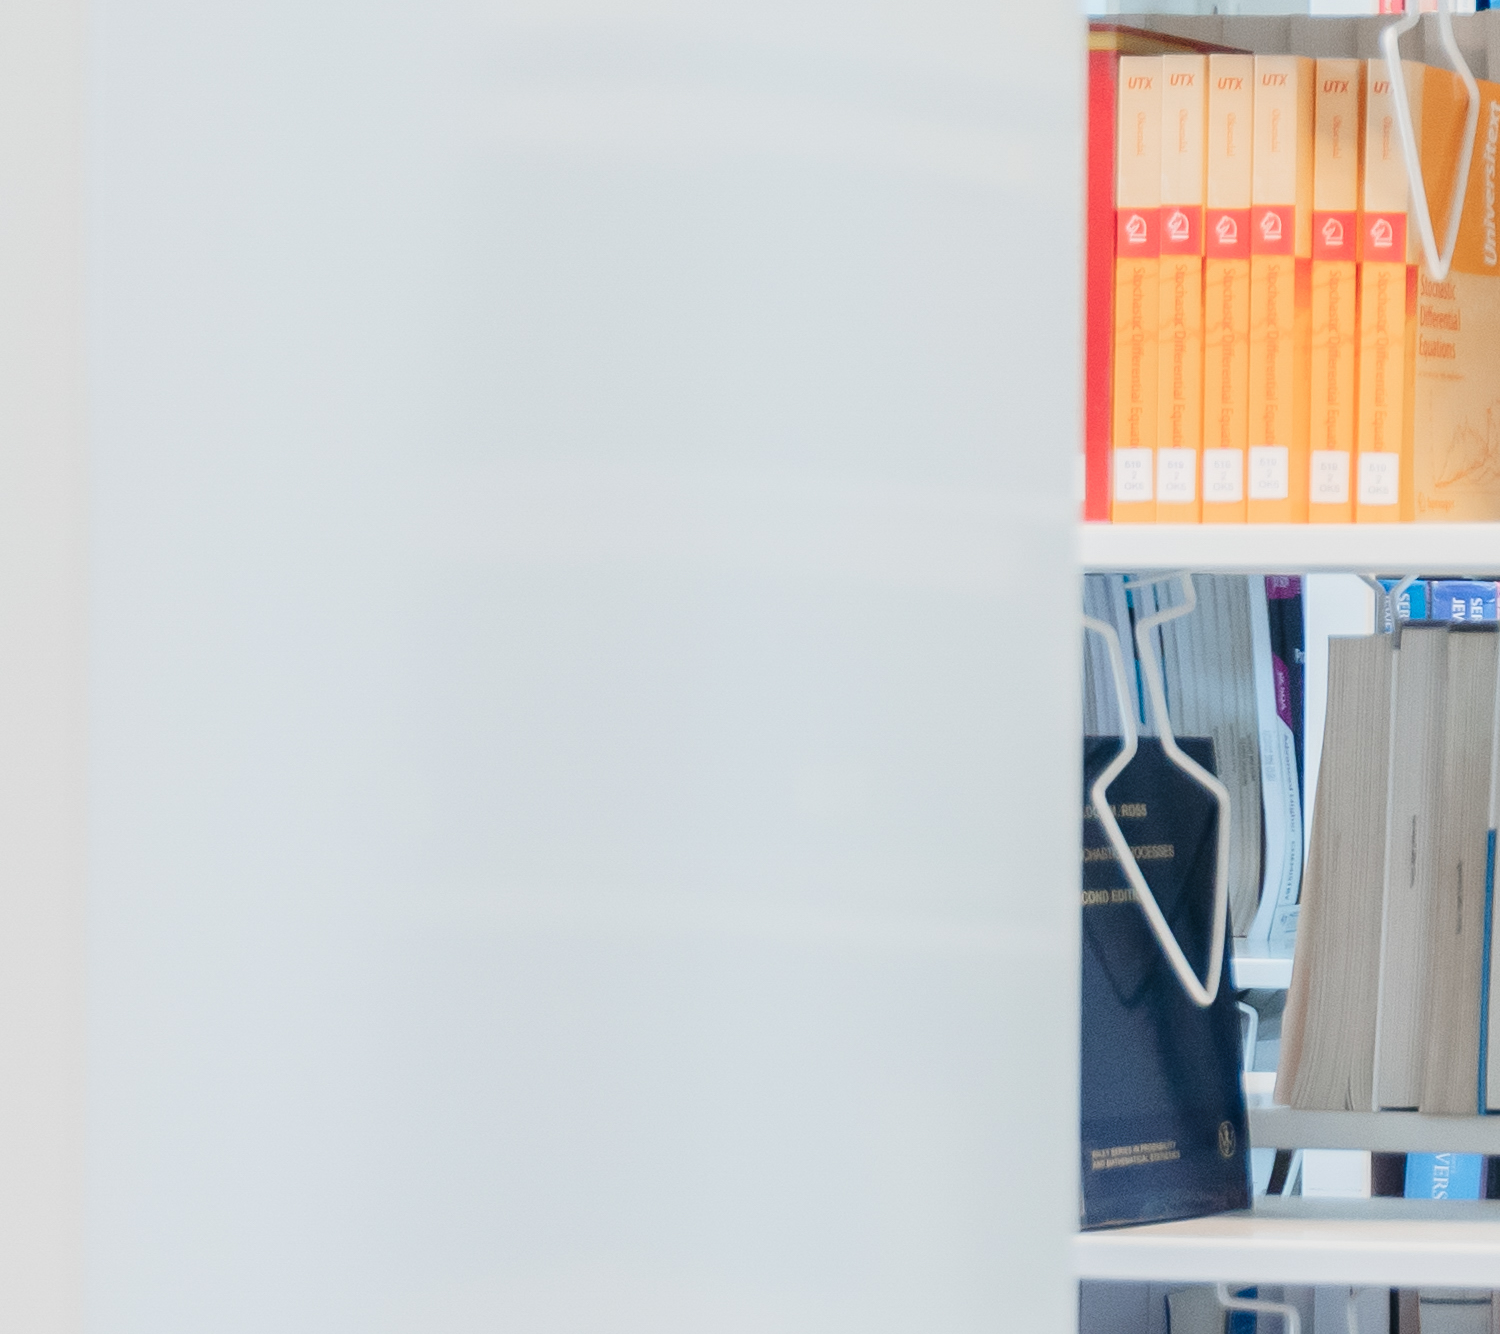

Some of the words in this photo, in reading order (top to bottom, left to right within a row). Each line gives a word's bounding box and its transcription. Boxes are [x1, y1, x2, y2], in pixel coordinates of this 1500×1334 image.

[1128, 77, 1153, 90] UTX
[1170, 74, 1195, 86] UTX
[1217, 77, 1243, 90] UTX
[1262, 73, 1288, 86] UTX
[1323, 80, 1350, 93] UTX
[1374, 81, 1394, 93] UT
[1133, 267, 1145, 330] Stochastic
[1175, 264, 1188, 328] Stochastic
[1223, 268, 1236, 331] Stochastic
[1267, 264, 1280, 327] Stochastic
[1329, 270, 1342, 333] Stochastic
[1378, 271, 1391, 333] Stochastic
[1420, 274, 1457, 301] Stochastic
[1419, 307, 1461, 332] Differential
[1131, 332, 1145, 403] Differential
[1173, 329, 1187, 401] Differential
[1221, 333, 1235, 405] Differential
[1265, 329, 1280, 401] Differential
[1327, 334, 1341, 406] Differential
[1418, 335, 1456, 361] Equations
[1375, 335, 1389, 408] Differential
[1399, 592, 1411, 619] SER
[1130, 844, 1175, 860] OCESSES
[1082, 890, 1110, 905] COND
[1111, 888, 1137, 903] EDIT
